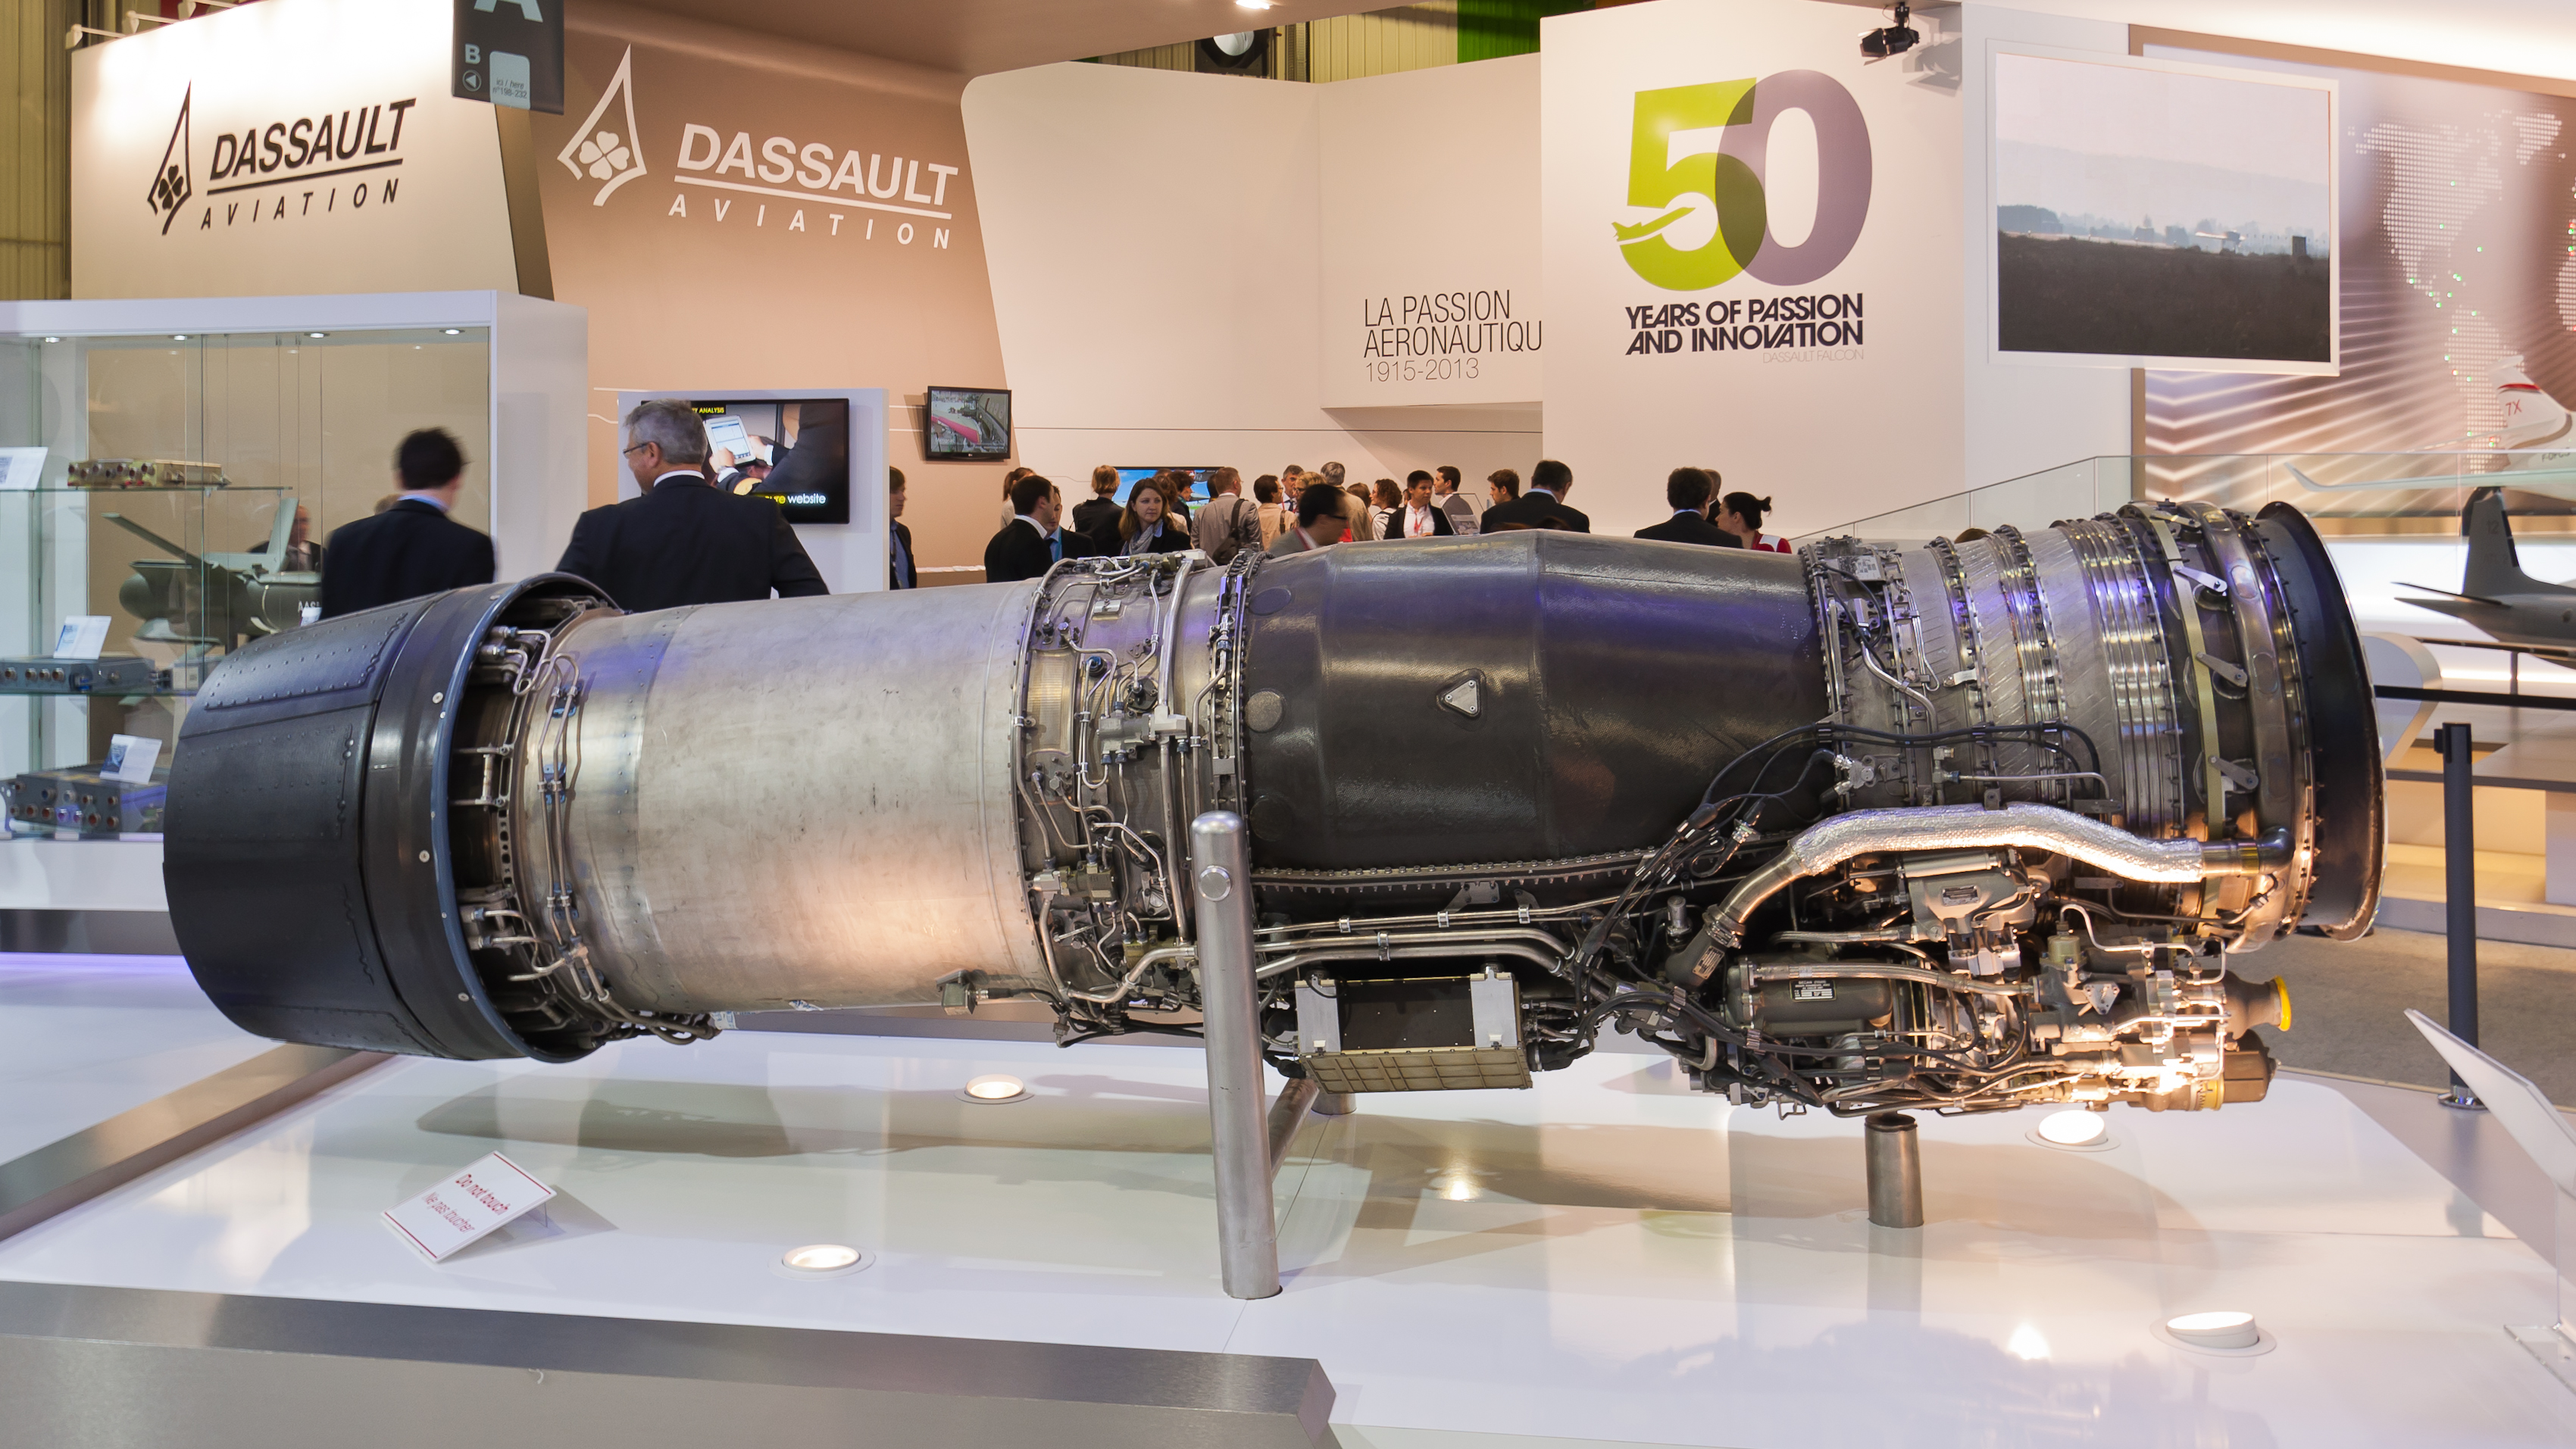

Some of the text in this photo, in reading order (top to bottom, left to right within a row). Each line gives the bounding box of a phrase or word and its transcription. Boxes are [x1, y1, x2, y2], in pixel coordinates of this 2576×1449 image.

[464, 43, 481, 64] B
[210, 98, 416, 181] DASSAULT
[677, 123, 958, 205] DASSAULT
[201, 178, 399, 230] AVIATION
[668, 194, 950, 249] AVIATION
[1365, 289, 1510, 326] LA PASSION
[1625, 293, 1863, 329] YEARS OF PASSION
[1625, 320, 1863, 355] AND INNOVATION
[1365, 358, 1479, 382] 1915-2013
[1763, 348, 1864, 364] DASSAULT FALCON
[2505, 399, 2522, 417] 7X
[787, 493, 826, 504] website
